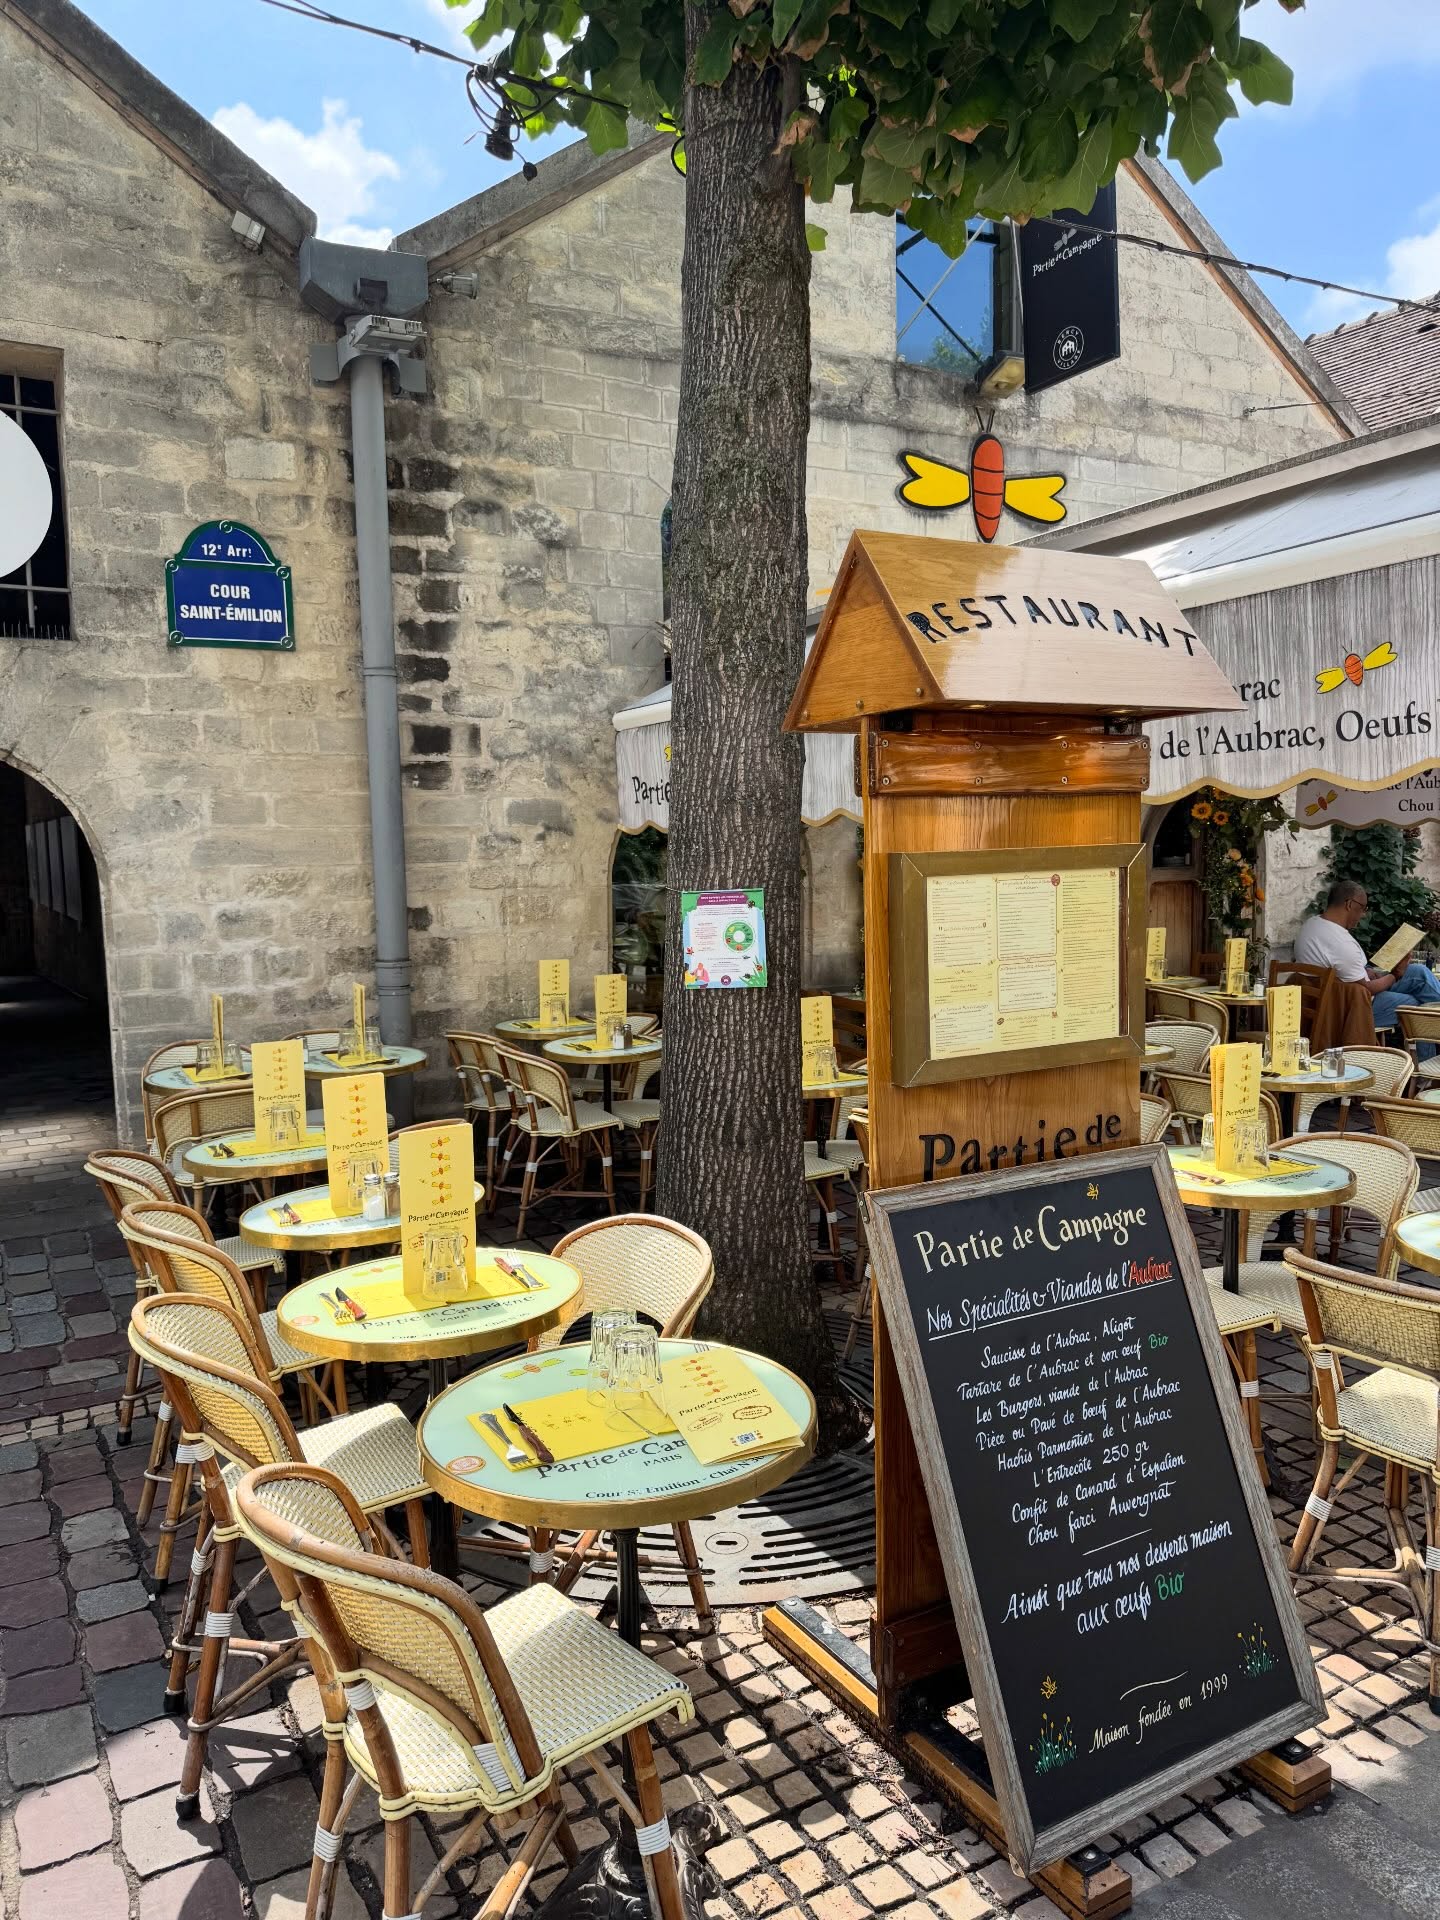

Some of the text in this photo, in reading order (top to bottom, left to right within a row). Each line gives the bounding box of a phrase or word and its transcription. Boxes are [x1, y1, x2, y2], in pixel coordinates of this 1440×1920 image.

[1032, 257, 1055, 277] Partie
[1062, 232, 1103, 260] Campagne
[179, 603, 283, 624] SAINT-ÉMILION
[209, 583, 251, 600] COUR
[905, 595, 1198, 657] RESTAURANT
[1232, 678, 1282, 702] rac
[1160, 701, 1432, 760] de l'Aubrac, Oeufs
[1398, 798, 1435, 813] Chou
[918, 1113, 1122, 1183] Partie de
[408, 1214, 430, 1223] Partie
[435, 1207, 470, 1219] Campagne
[913, 1205, 1147, 1273] Partie de Campagne
[927, 1304, 952, 1334] Nos
[959, 1287, 1031, 1333] Spécialités
[1046, 1271, 1103, 1305] Viandes
[1105, 1267, 1119, 1289] de
[957, 1380, 1002, 1400] Tartare
[1009, 1374, 1021, 1389] de
[1084, 1352, 1094, 1367] et
[1101, 1350, 1118, 1363] son
[1149, 1334, 1169, 1349] Bio
[981, 1346, 1027, 1368] Saucisse
[1030, 1342, 1041, 1355] de
[1102, 1317, 1136, 1342] Aligot
[975, 1430, 1006, 1450] Pièce
[1012, 1427, 1025, 1440] ou
[1030, 1412, 1056, 1435] Pavé
[1063, 1411, 1075, 1426] de
[1115, 1393, 1126, 1409] de
[976, 1406, 992, 1424] Les
[1048, 1384, 1080, 1404] viande
[1088, 1376, 1099, 1391] de
[535, 1452, 618, 1480] Partie
[618, 1446, 638, 1458] de
[642, 1453, 683, 1467] PARIS
[998, 1448, 1033, 1472] Hachis
[1038, 1430, 1094, 1459] Parmentier
[1102, 1424, 1114, 1439] de
[1103, 1443, 1129, 1464] 250
[1135, 1440, 1149, 1461] gr
[585, 1489, 625, 1499] Cour
[646, 1479, 701, 1494] Emilion
[1012, 1498, 1048, 1525] Confit
[1057, 1491, 1068, 1508] de
[1076, 1473, 1117, 1500] Canard
[1029, 1480, 1176, 1546] Chou farci Auvergnat
[1001, 1519, 1232, 1623] Ainsi que tous nos desserts maison
[1077, 1602, 1110, 1634] aux
[1154, 1570, 1185, 1601] Bio
[1088, 1673, 1229, 1753] Maison fondée en 1999
